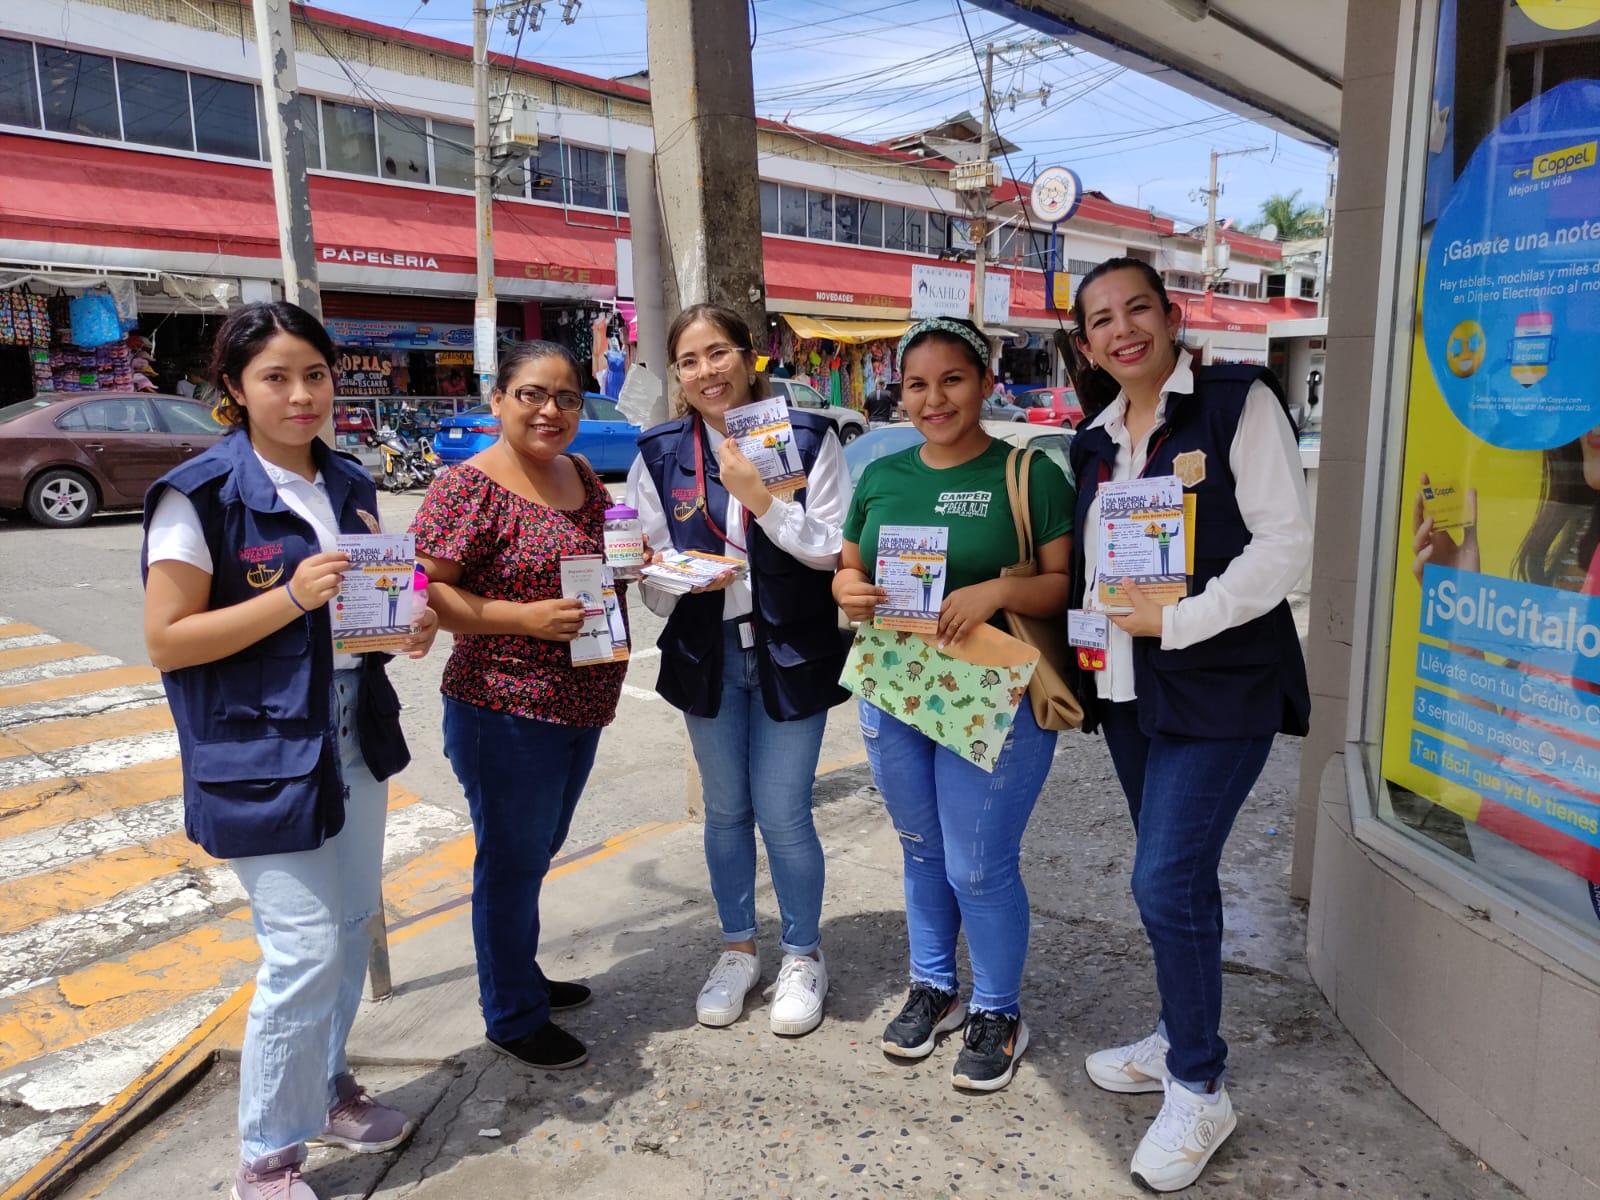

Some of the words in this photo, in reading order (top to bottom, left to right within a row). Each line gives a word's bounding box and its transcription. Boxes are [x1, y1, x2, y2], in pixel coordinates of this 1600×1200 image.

[1538, 147, 1590, 174] Coppel
[1508, 182, 1539, 197] Mejora
[1541, 180, 1550, 190] tu
[1553, 174, 1573, 187] vida
[1443, 237, 1510, 267] ¡Gánate
[1514, 231, 1549, 252] una
[1555, 220, 1600, 245] note
[322, 247, 439, 269] PAPELERIA
[1440, 279, 1458, 292] Hay
[1459, 275, 1495, 289] tablets,
[1497, 269, 1545, 285] mochilas
[1547, 270, 1557, 281] y
[1557, 262, 1589, 278] miles
[816, 291, 854, 303] NOVEDADES
[928, 286, 966, 301] KAHLO
[1453, 294, 1465, 304] en
[1467, 291, 1500, 303] Dinero
[1502, 284, 1564, 300] Electrónico
[1567, 280, 1578, 293] al
[941, 493, 990, 501] CAMPER
[1426, 580, 1600, 658] ¡Solicítalo
[1420, 652, 1468, 682] Llévate
[1470, 672, 1497, 692] con
[1500, 680, 1515, 698] tu
[1519, 684, 1581, 719] Crédito
[1417, 697, 1427, 713] 3
[1428, 703, 1485, 736] sencillos
[1487, 727, 1535, 755] pasos:
[1413, 739, 1438, 764] Tan
[1441, 751, 1470, 778] fácil
[1473, 769, 1501, 791] que
[1503, 781, 1523, 801] ya
[1527, 787, 1542, 808] lo
[1545, 796, 1599, 834] tienes
